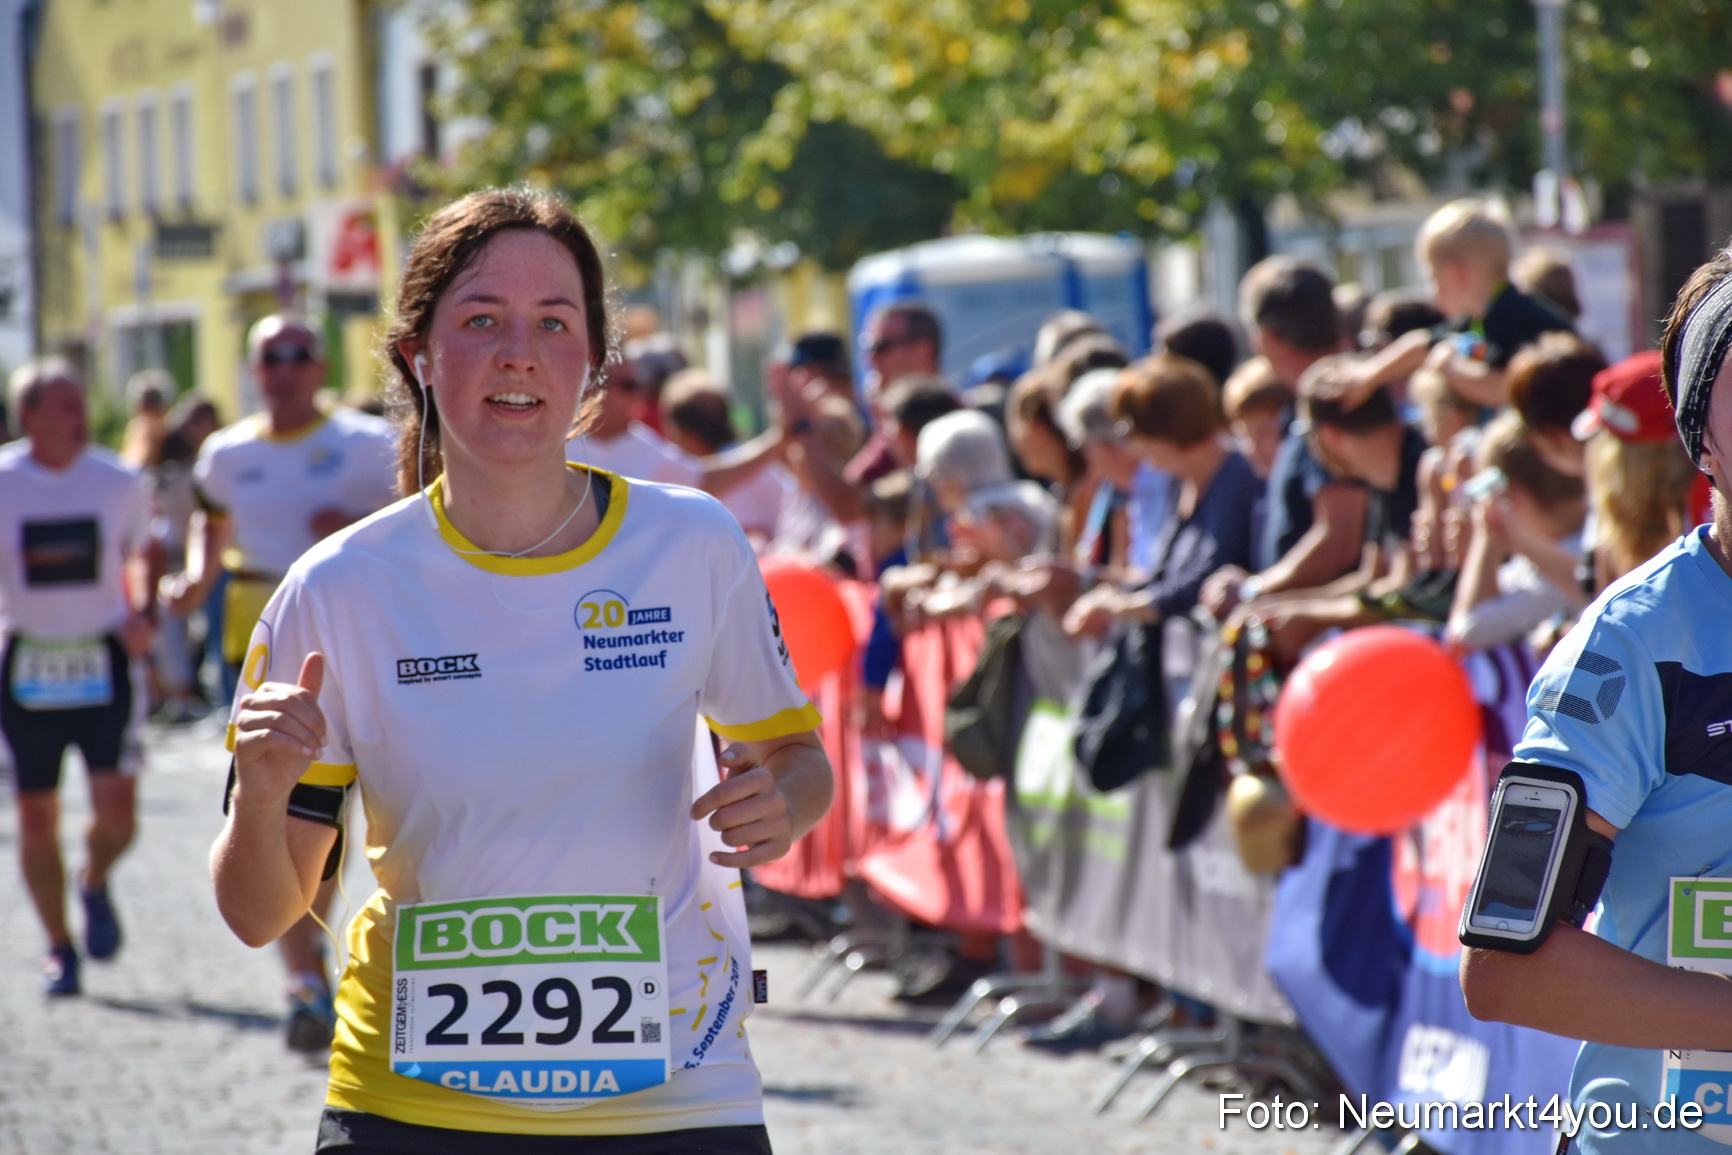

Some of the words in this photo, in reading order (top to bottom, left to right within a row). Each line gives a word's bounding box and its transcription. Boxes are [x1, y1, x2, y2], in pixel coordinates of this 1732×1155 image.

[581, 600, 625, 629] 20
[631, 609, 668, 625] JAHRE
[583, 629, 685, 650] Neumarkter
[397, 653, 481, 678] BOCK
[584, 649, 668, 672] Stadtlauf
[414, 903, 642, 962] BOCK
[425, 975, 635, 1047] 2292
[643, 982, 656, 995] D
[693, 985, 736, 1060] September
[440, 1068, 621, 1094] CLAUDIA
